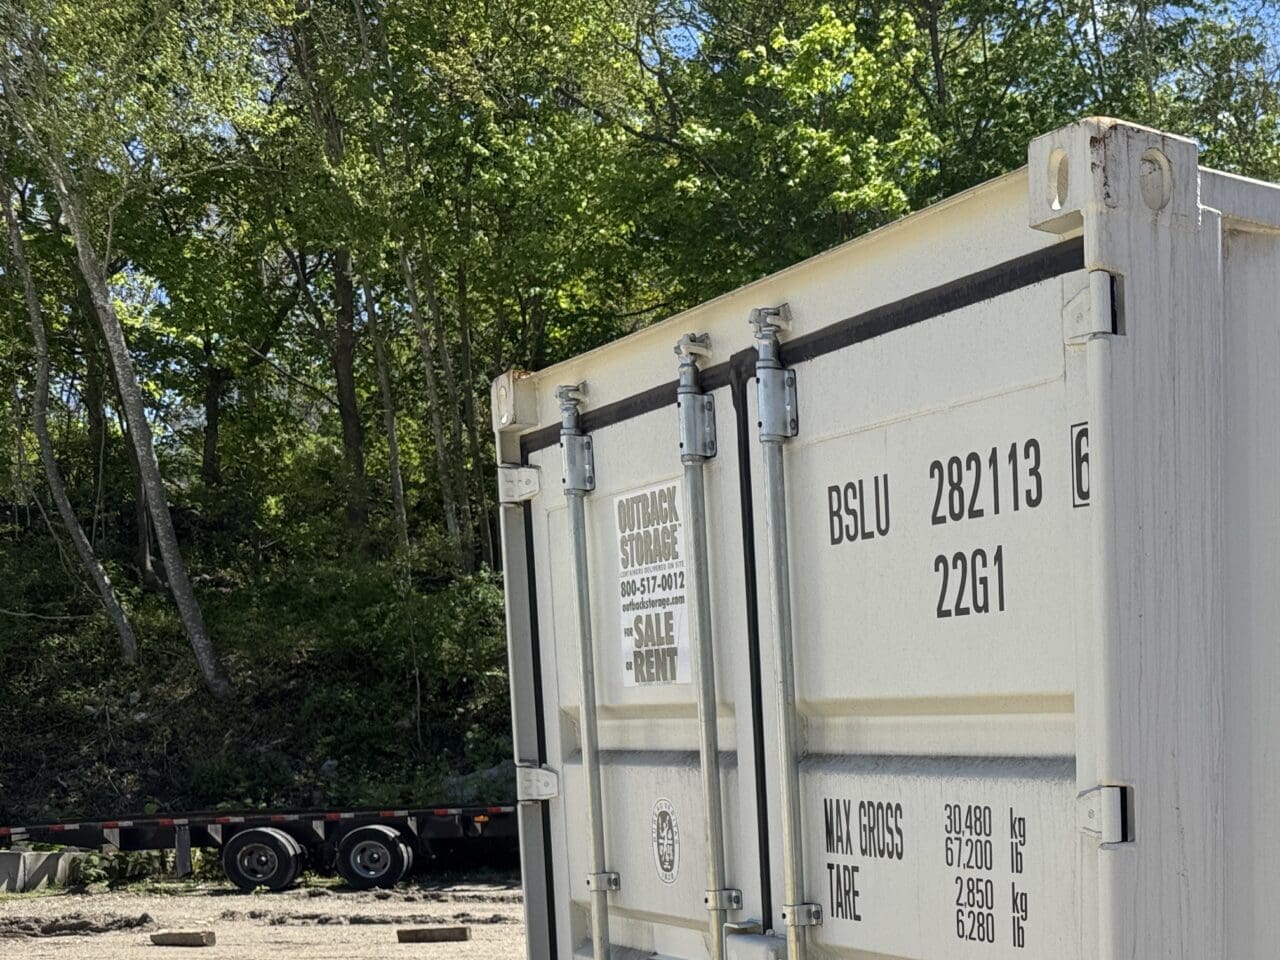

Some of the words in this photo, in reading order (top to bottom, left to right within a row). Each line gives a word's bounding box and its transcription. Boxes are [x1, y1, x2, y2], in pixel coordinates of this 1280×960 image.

[828, 474, 890, 545] BSLU
[930, 438, 1042, 525] 282113
[1075, 427, 1090, 501] 6
[618, 486, 679, 533] OUTBACK
[620, 524, 678, 569] STORAGE
[621, 571, 684, 597] 800-517-0012
[934, 545, 1004, 618] 22G1
[623, 595, 684, 612] outbackstorage.com
[624, 628, 633, 637] FOR
[634, 612, 674, 648] SALE
[633, 647, 678, 682] RENT
[824, 798, 853, 855] MAX
[859, 800, 903, 860] GROSS
[945, 804, 992, 837] 30,480
[1010, 807, 1026, 846] kg
[945, 837, 993, 870] 67,200
[1011, 842, 1023, 873] lb
[827, 863, 861, 921] TARE
[955, 876, 994, 910] 2,850
[1012, 882, 1028, 921] kg
[956, 909, 994, 943] 6,280
[1013, 916, 1024, 948] lb
